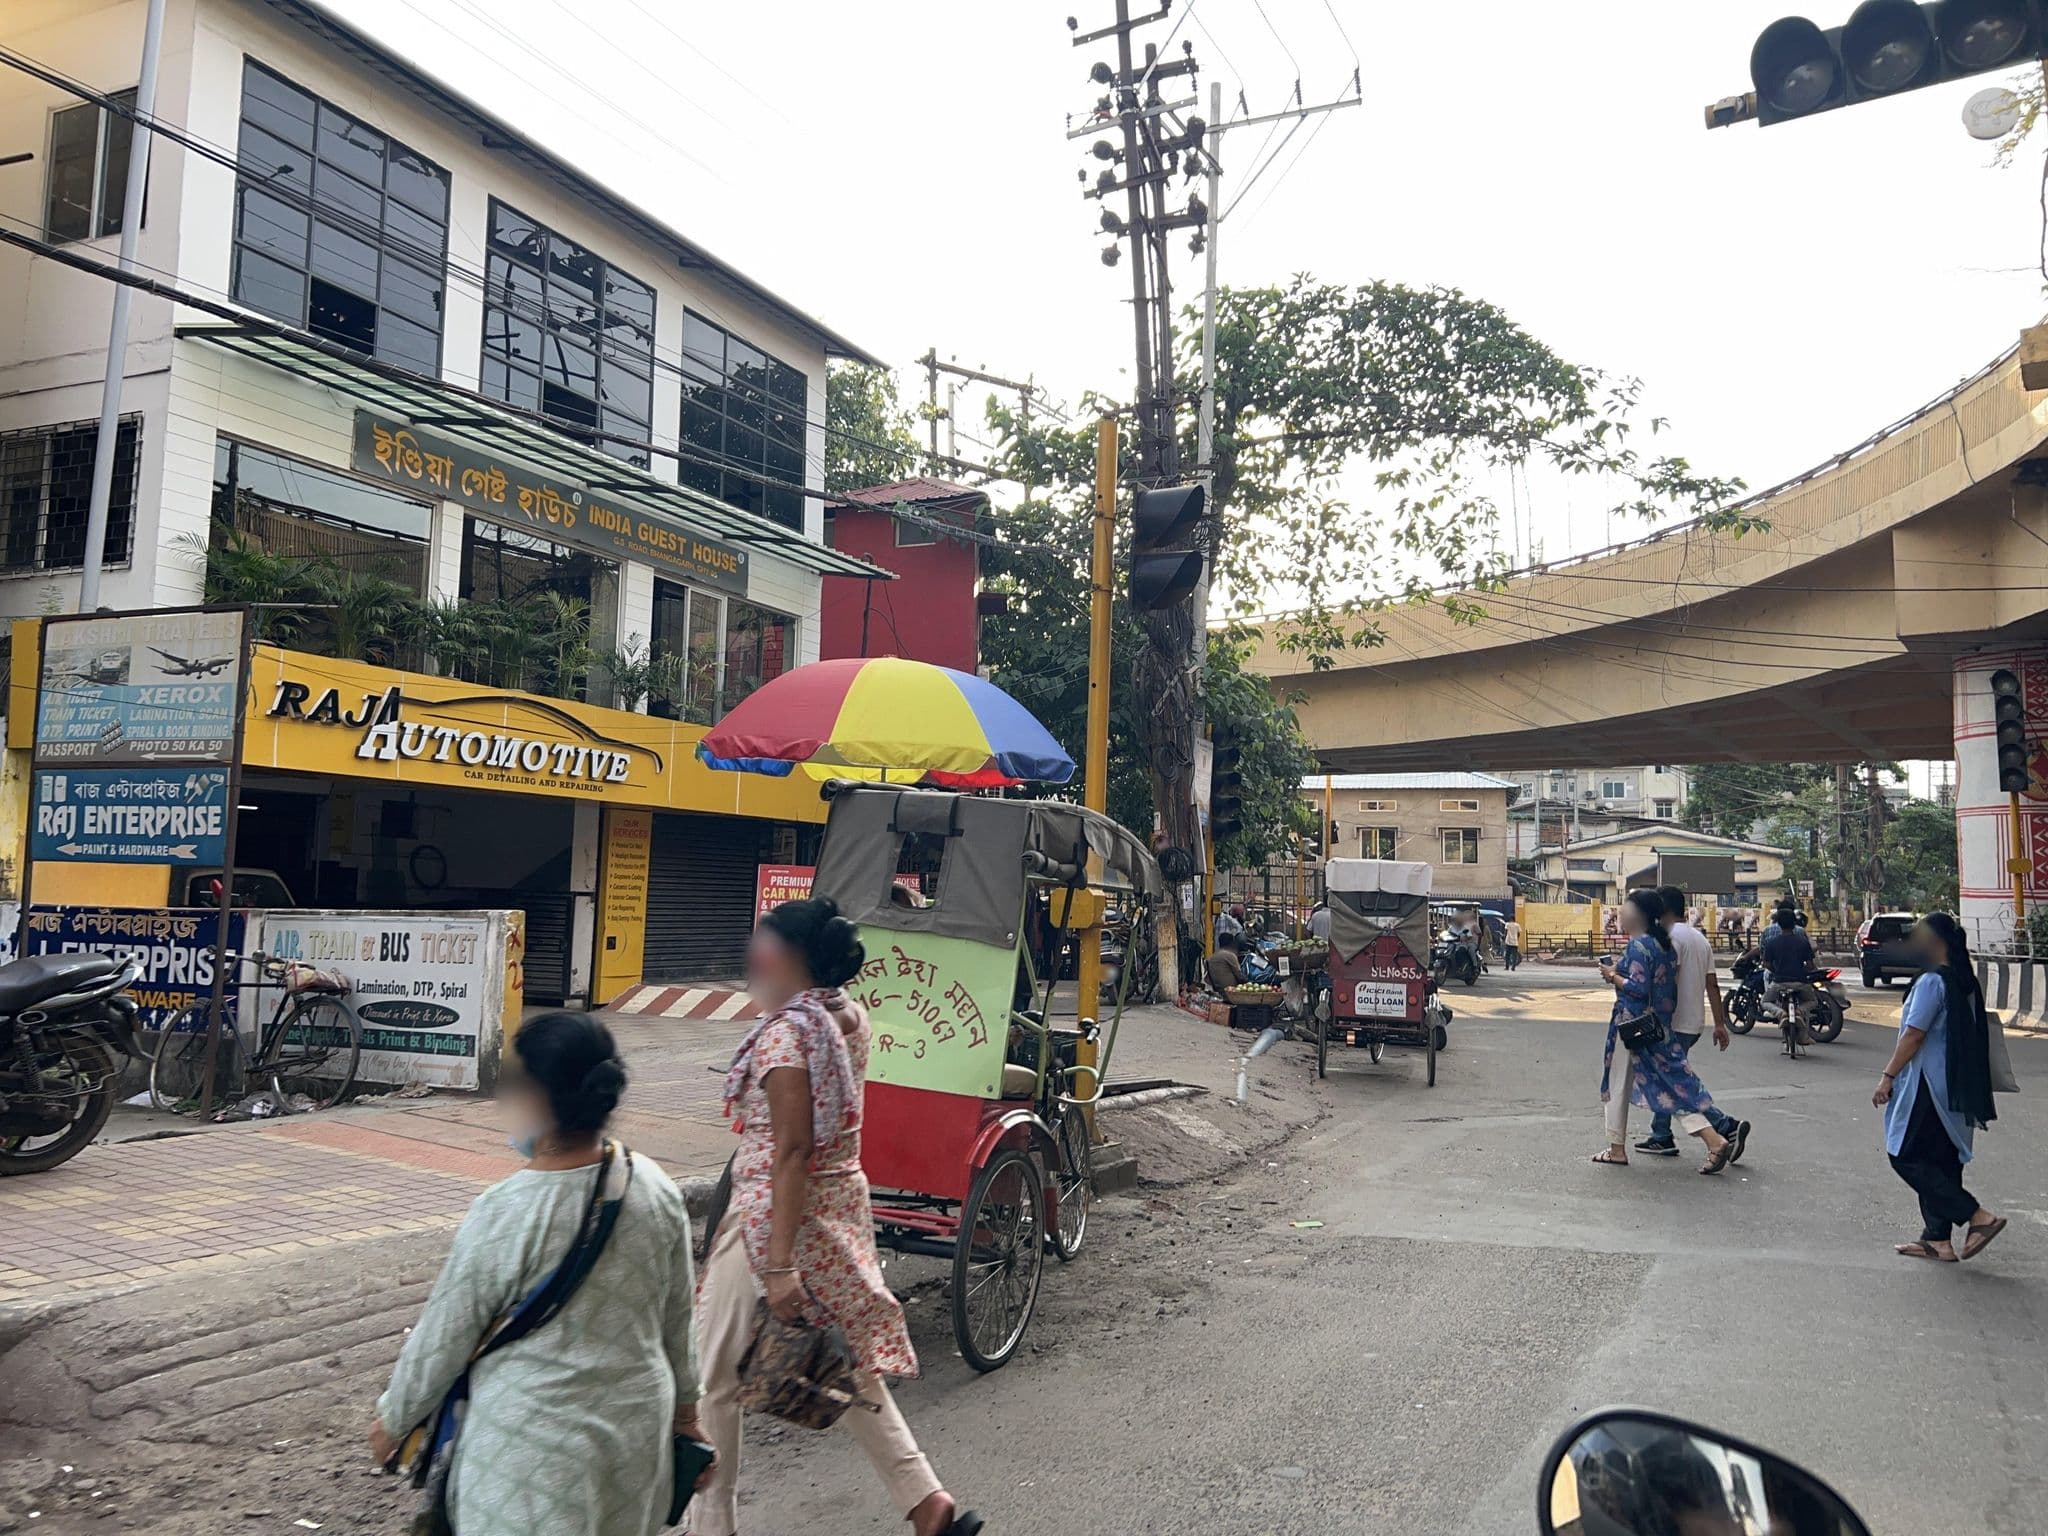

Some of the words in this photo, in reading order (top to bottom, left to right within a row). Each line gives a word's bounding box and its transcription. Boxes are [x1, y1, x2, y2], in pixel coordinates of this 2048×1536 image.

[588, 504, 632, 537] INDIA
[637, 522, 687, 555] GUEST
[692, 541, 738, 574] HOUSE
[136, 687, 224, 704] XEROX
[44, 707, 76, 720] TRAIN
[78, 706, 116, 720] TICKET
[67, 723, 101, 737] PRINT
[165, 725, 189, 737] BOOK
[192, 725, 229, 737] BINDING
[356, 686, 632, 783] AUTOMOTIVE
[40, 743, 97, 756] PASSPORT
[129, 741, 169, 751] PHOTO
[172, 741, 185, 751] 50
[188, 741, 205, 751] KA
[208, 740, 223, 751] 50
[464, 770, 484, 780] CAR
[487, 773, 536, 786] DETAILING
[539, 779, 557, 788] AND
[559, 781, 604, 793] REPAIRING
[38, 806, 77, 840] RAJ
[84, 806, 222, 839] ENTERPRISE
[82, 843, 107, 855] PAINT
[111, 845, 116, 855] &
[119, 844, 169, 856] HARDWARE
[762, 887, 786, 899] CAR
[788, 888, 811, 900] WAS
[309, 930, 357, 960] TRAIN
[380, 932, 410, 962] BUS
[420, 933, 478, 964] TICKET
[356, 979, 409, 998] Lamination,
[413, 980, 436, 999] DTP,
[440, 982, 468, 1000] Spiral
[1357, 996, 1380, 1005] GOLD
[1382, 997, 1404, 1006] LOAN
[379, 1031, 406, 1047] Print
[409, 1035, 420, 1048] &
[424, 1034, 467, 1055] Binding
